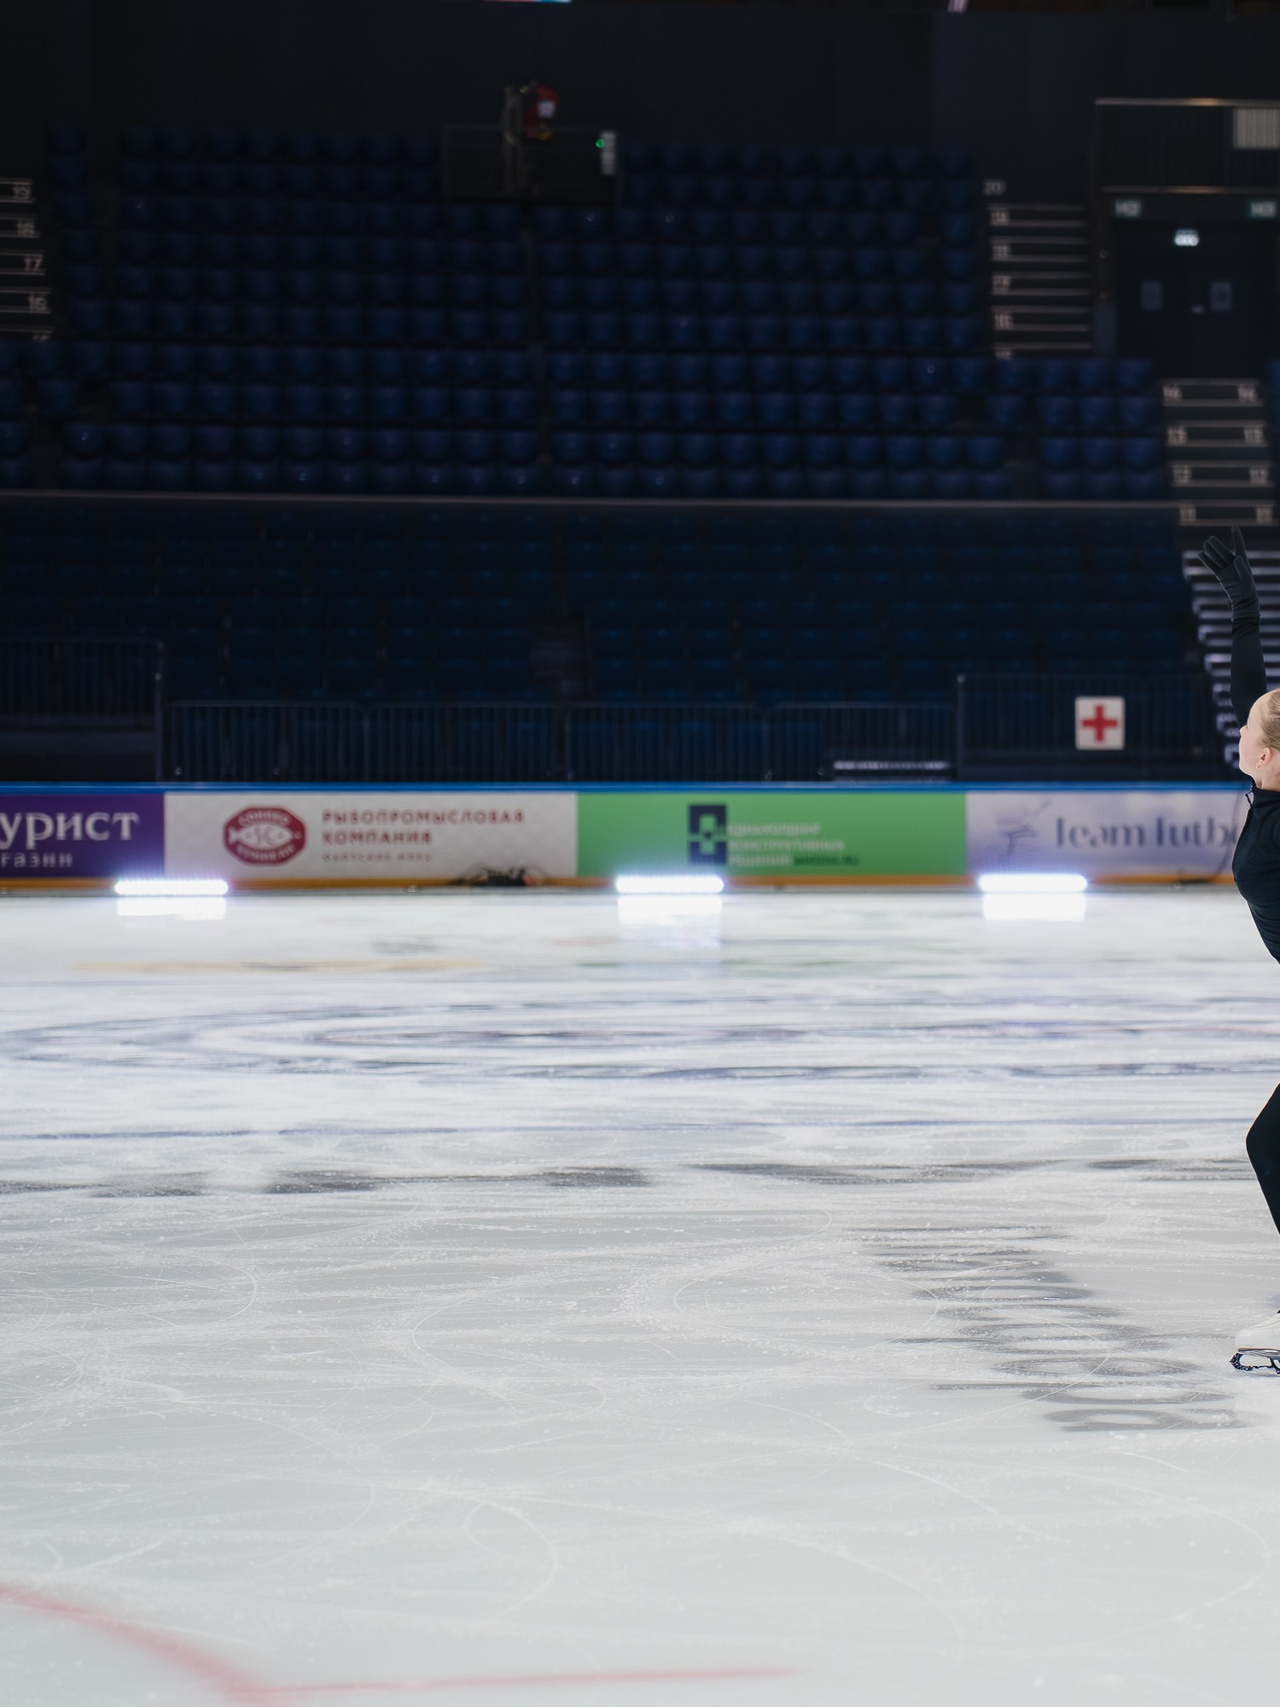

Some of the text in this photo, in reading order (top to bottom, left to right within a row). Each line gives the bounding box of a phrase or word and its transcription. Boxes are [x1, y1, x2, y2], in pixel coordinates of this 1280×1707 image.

[23, 256, 43, 272] 17
[322, 808, 525, 825] РЫБОПРОМЫСЛОВАЯ
[0, 812, 140, 850] урист
[322, 829, 433, 845] КОМПАНИЯ
